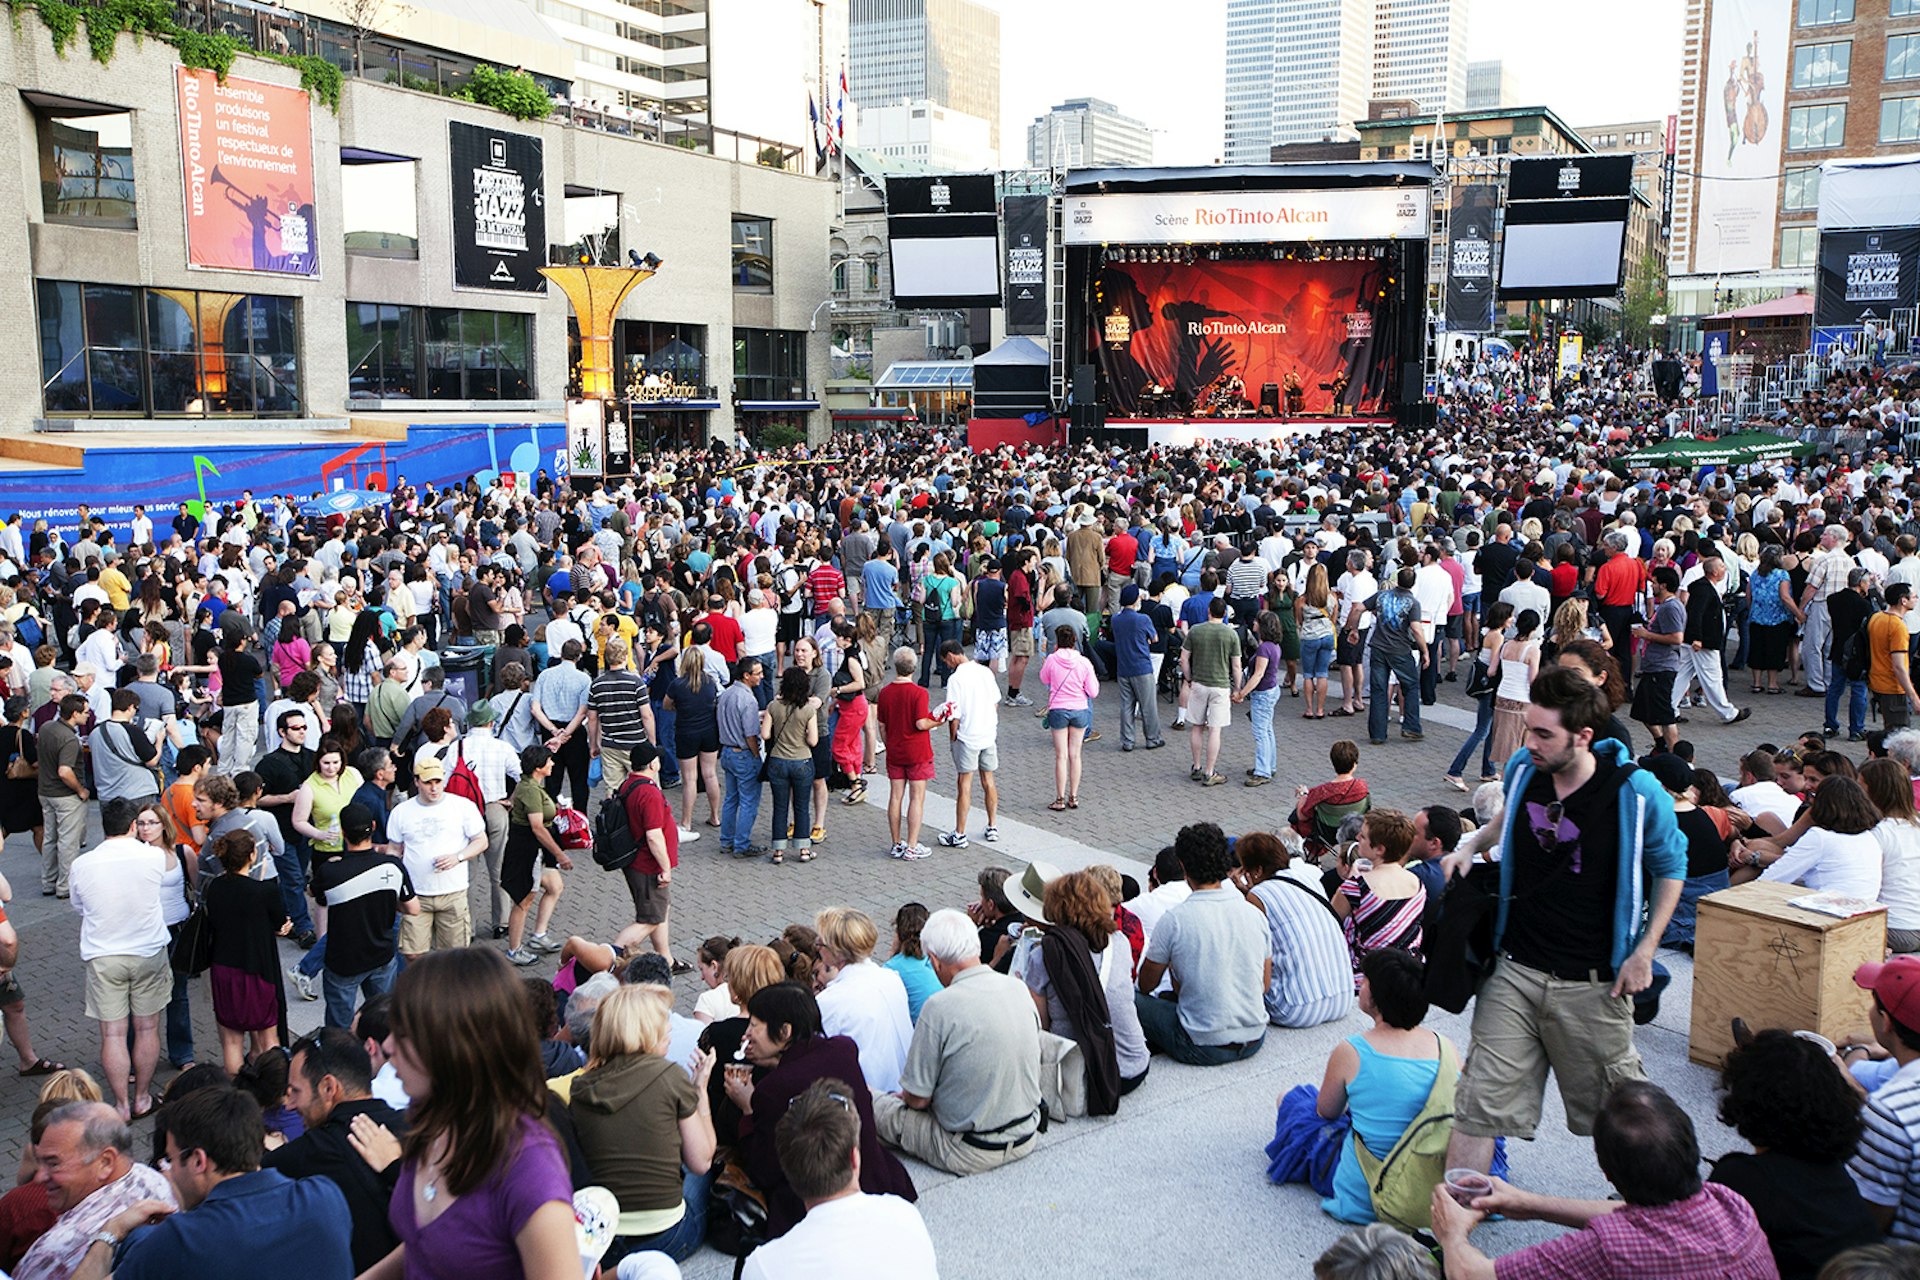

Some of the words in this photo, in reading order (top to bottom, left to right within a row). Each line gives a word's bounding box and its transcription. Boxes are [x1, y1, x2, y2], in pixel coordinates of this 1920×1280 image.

[213, 81, 264, 104] Ensemble
[215, 101, 271, 122] produisons
[216, 118, 230, 131] un
[232, 118, 269, 138] festival
[217, 135, 279, 156] respectueux
[281, 144, 294, 158] de
[217, 149, 298, 175] l'environnement
[473, 168, 524, 189] FESTIVAL
[475, 194, 526, 226] JAZZ
[1154, 213, 1189, 226] Scène
[1009, 258, 1043, 272] JAZZ
[1453, 251, 1490, 265] JAZZ
[1848, 253, 1901, 264] FESTIVAL
[1847, 267, 1900, 285] JAZZ
[1698, 457, 1730, 465] Heineken
[19, 509, 42, 519] Nous
[108, 505, 134, 515] mieux
[119, 521, 131, 530] you
